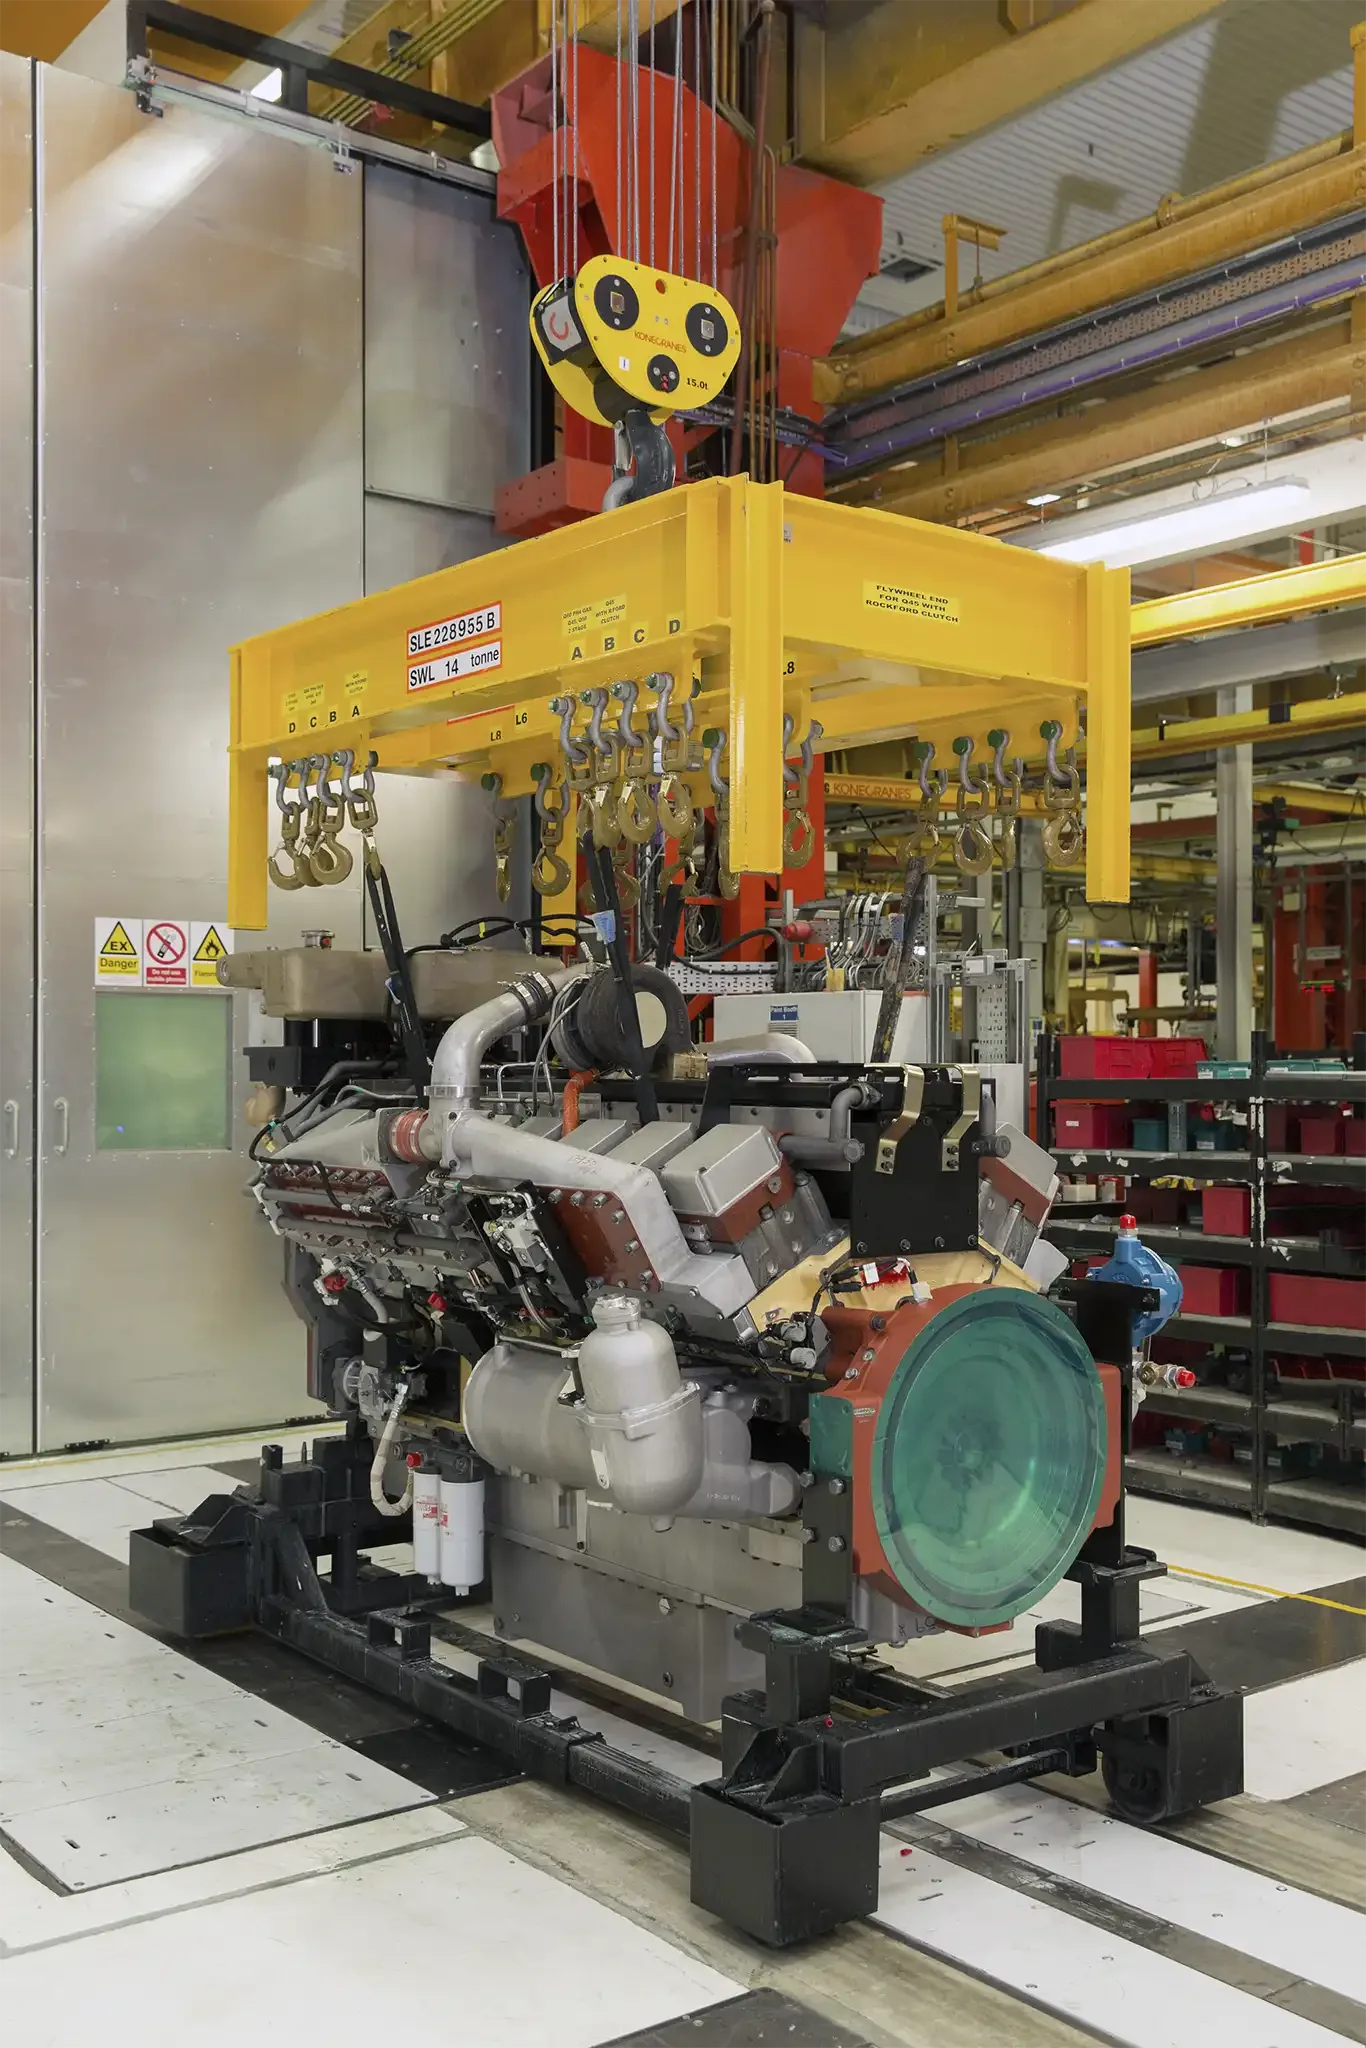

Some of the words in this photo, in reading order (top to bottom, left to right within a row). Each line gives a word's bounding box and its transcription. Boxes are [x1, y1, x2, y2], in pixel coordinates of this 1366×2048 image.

[634, 330, 687, 354] KONECRANES
[686, 378, 708, 390] 15.0t
[876, 584, 927, 600] FLYWHEEL
[929, 595, 949, 605] END
[879, 593, 899, 602] FOR
[901, 598, 920, 607] Q45
[921, 602, 946, 612] WITH
[486, 611, 495, 629] B
[600, 614, 620, 624] CLUTCH
[865, 599, 919, 615] ROCKFORD
[921, 610, 959, 623] CLUTCH
[571, 646, 582, 660] A
[604, 637, 615, 651] B
[633, 629, 645, 643] C
[669, 619, 681, 634] D
[410, 665, 435, 686] SWL
[445, 658, 459, 677] 14
[471, 649, 499, 667] tonne
[289, 722, 296, 733] D
[310, 716, 317, 728] C
[329, 711, 337, 722] B
[352, 705, 360, 717] A
[515, 712, 528, 725] L6
[490, 730, 502, 741] L8
[833, 783, 912, 800] KONECRANES
[110, 941, 128, 952] EX
[100, 957, 138, 969] Danger
